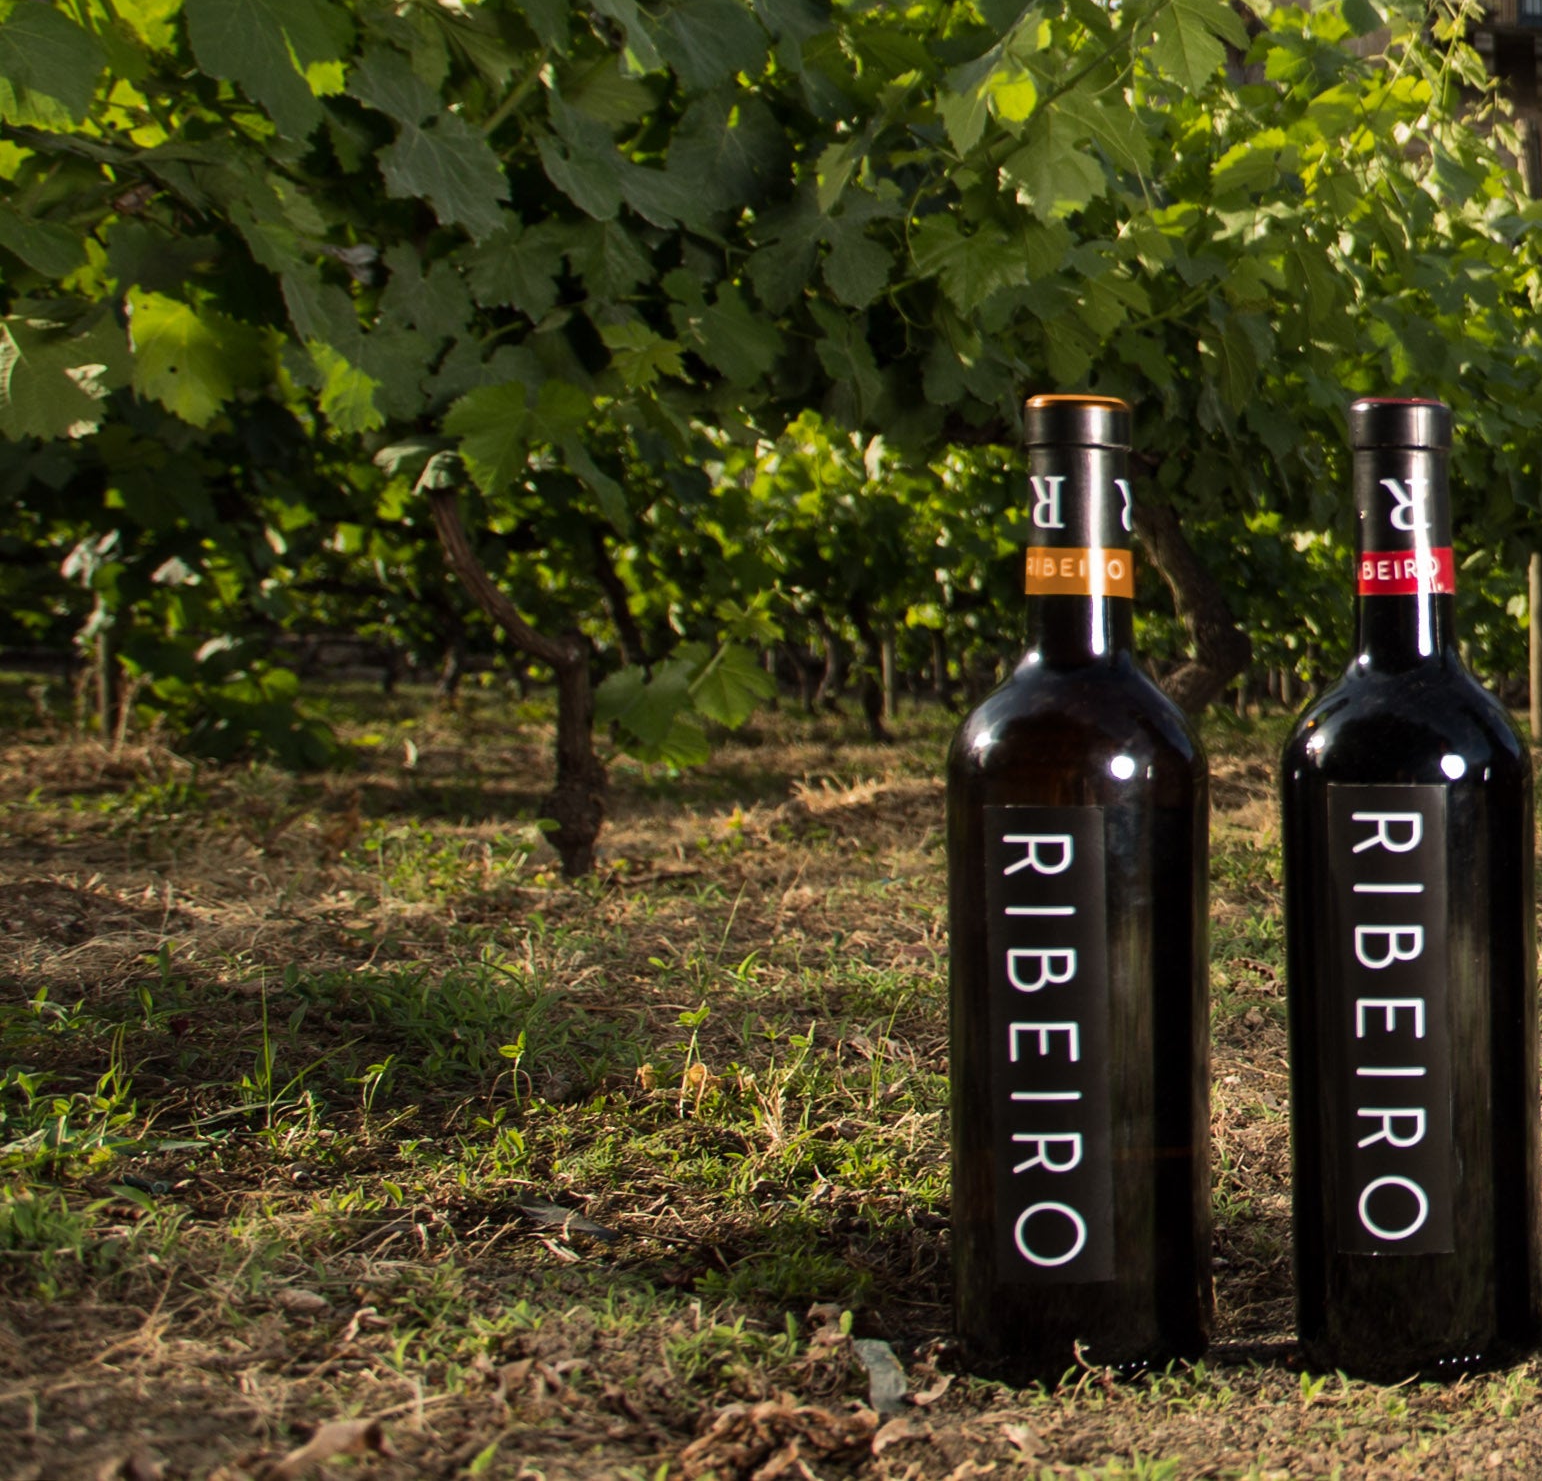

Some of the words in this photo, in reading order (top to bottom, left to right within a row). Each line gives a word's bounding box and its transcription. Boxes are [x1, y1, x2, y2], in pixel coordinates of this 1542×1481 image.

[1027, 556, 1126, 580] RIBEIO
[1002, 833, 1086, 1267] RIBEIRO
[1351, 811, 1429, 1241] RIBEIRO
